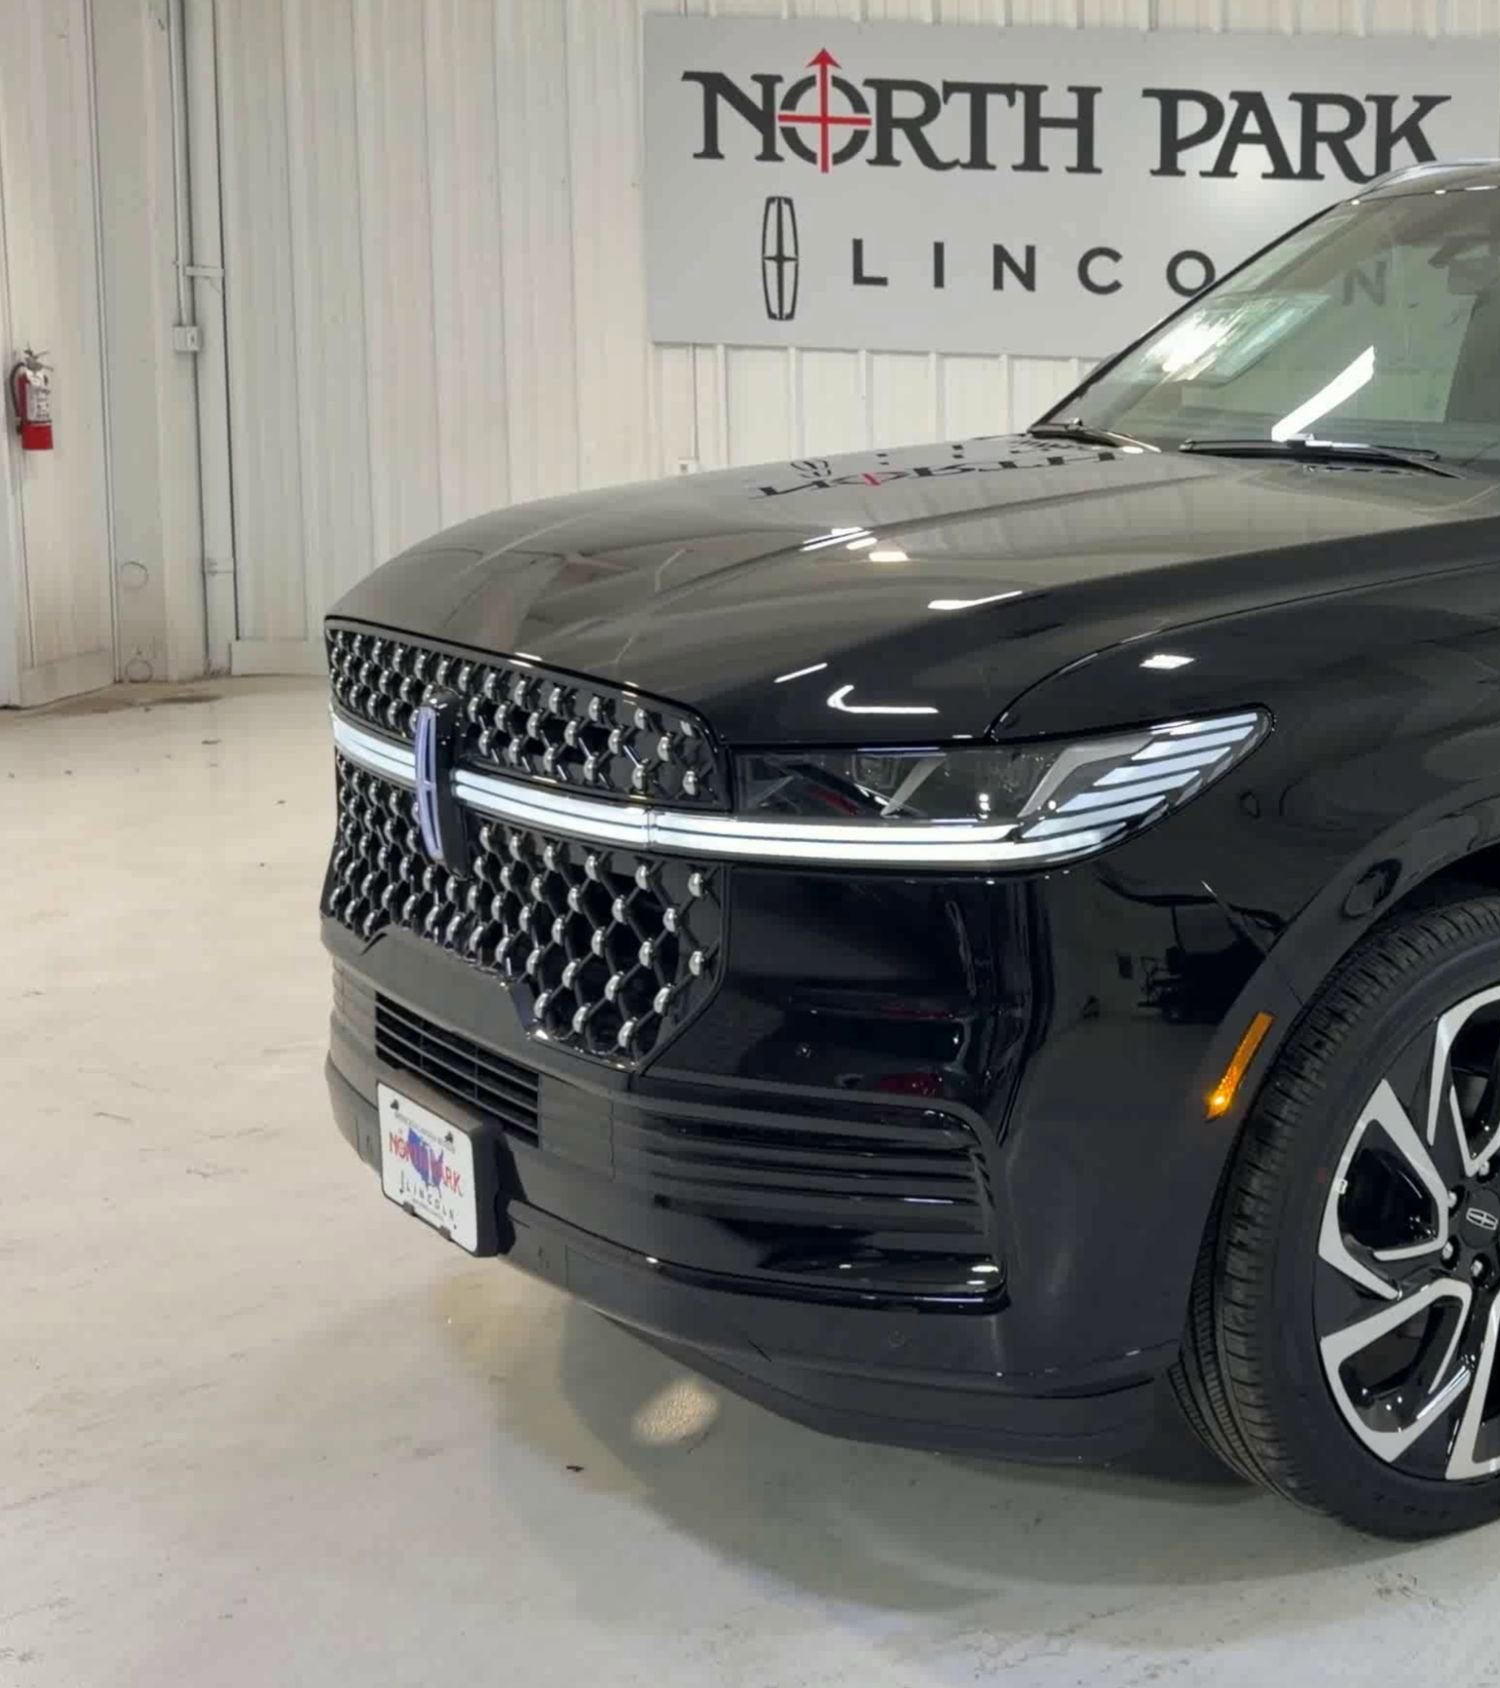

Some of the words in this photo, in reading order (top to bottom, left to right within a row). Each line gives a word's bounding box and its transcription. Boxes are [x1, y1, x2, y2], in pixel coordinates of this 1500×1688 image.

[682, 70, 1102, 174] NORTH
[1142, 88, 1452, 184] PARK
[853, 238, 1388, 307] LINCON
